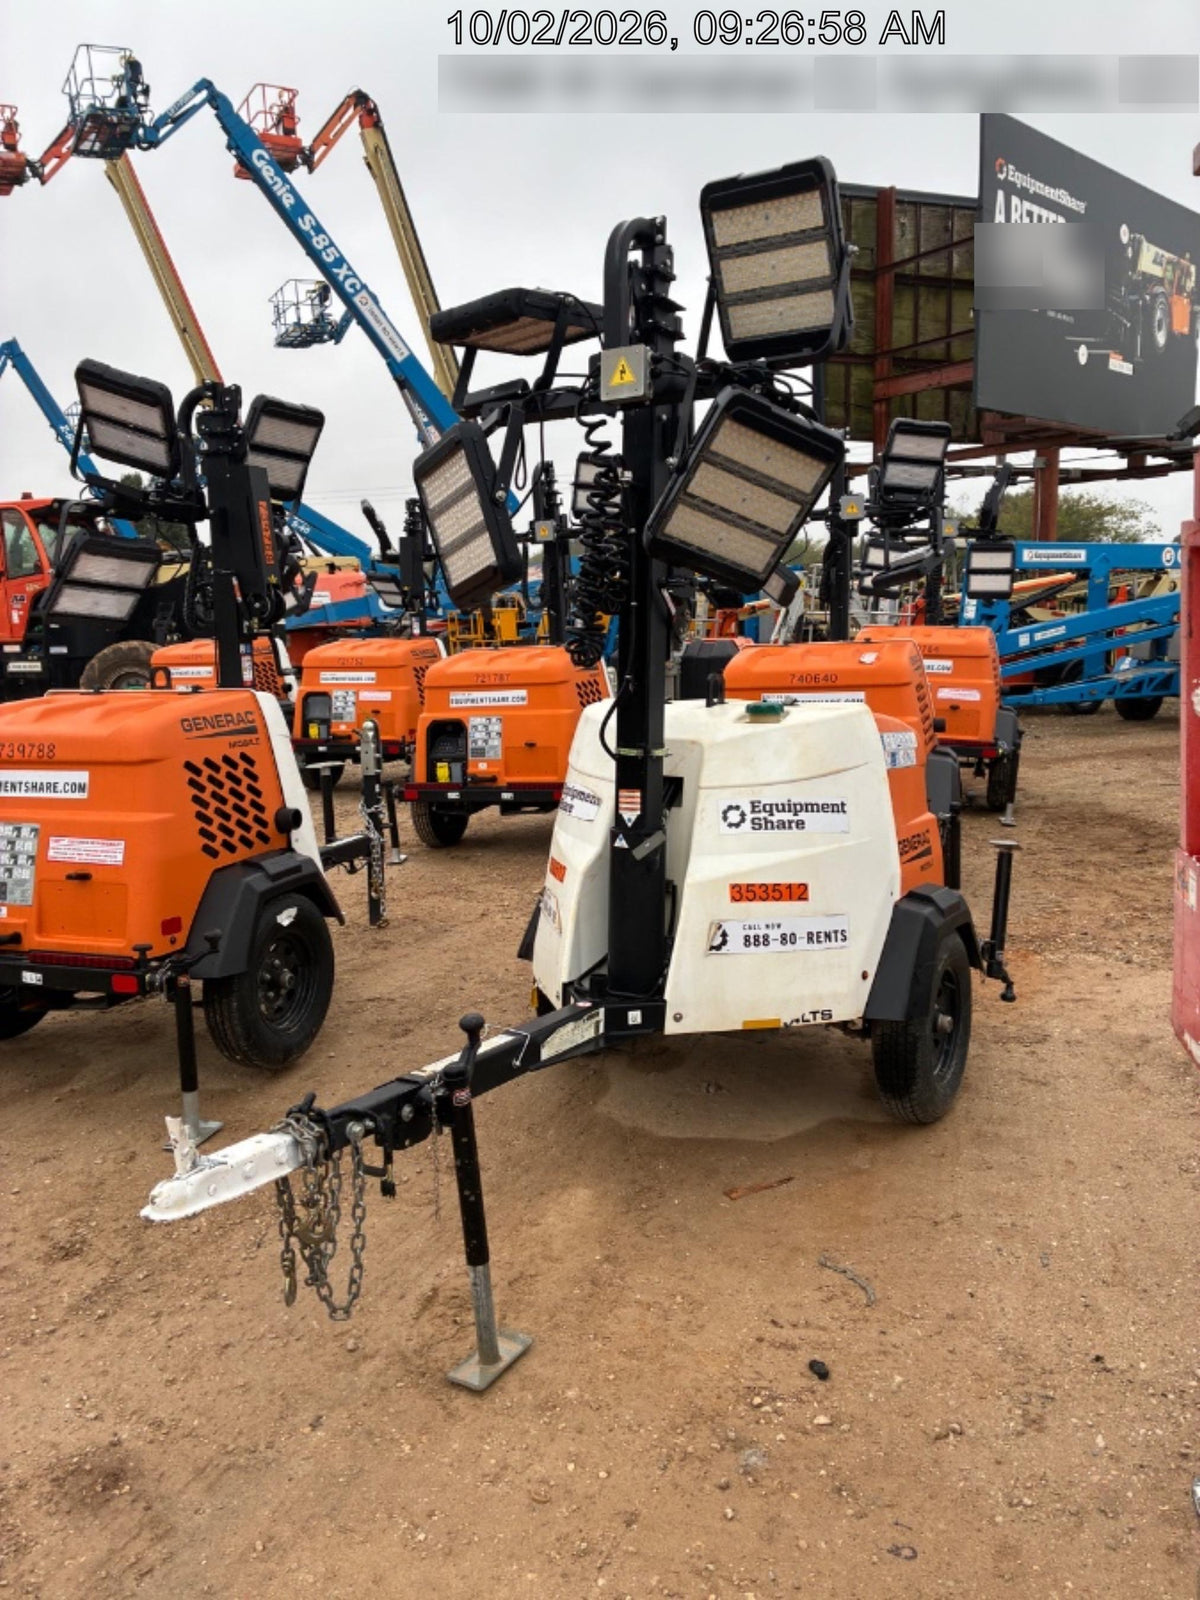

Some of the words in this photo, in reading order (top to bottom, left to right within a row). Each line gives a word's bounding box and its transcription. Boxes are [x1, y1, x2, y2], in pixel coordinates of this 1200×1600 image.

[1007, 163, 1085, 214] EquipmentShare
[994, 189, 1006, 223] A
[251, 148, 295, 209] Genie
[298, 213, 339, 262] S-85
[332, 265, 361, 293] XC
[181, 711, 256, 732] GENERAC
[750, 798, 847, 815] Equipment
[750, 816, 806, 831] Share
[730, 883, 809, 902] 353512
[743, 929, 848, 948] 888-80-RENTS
